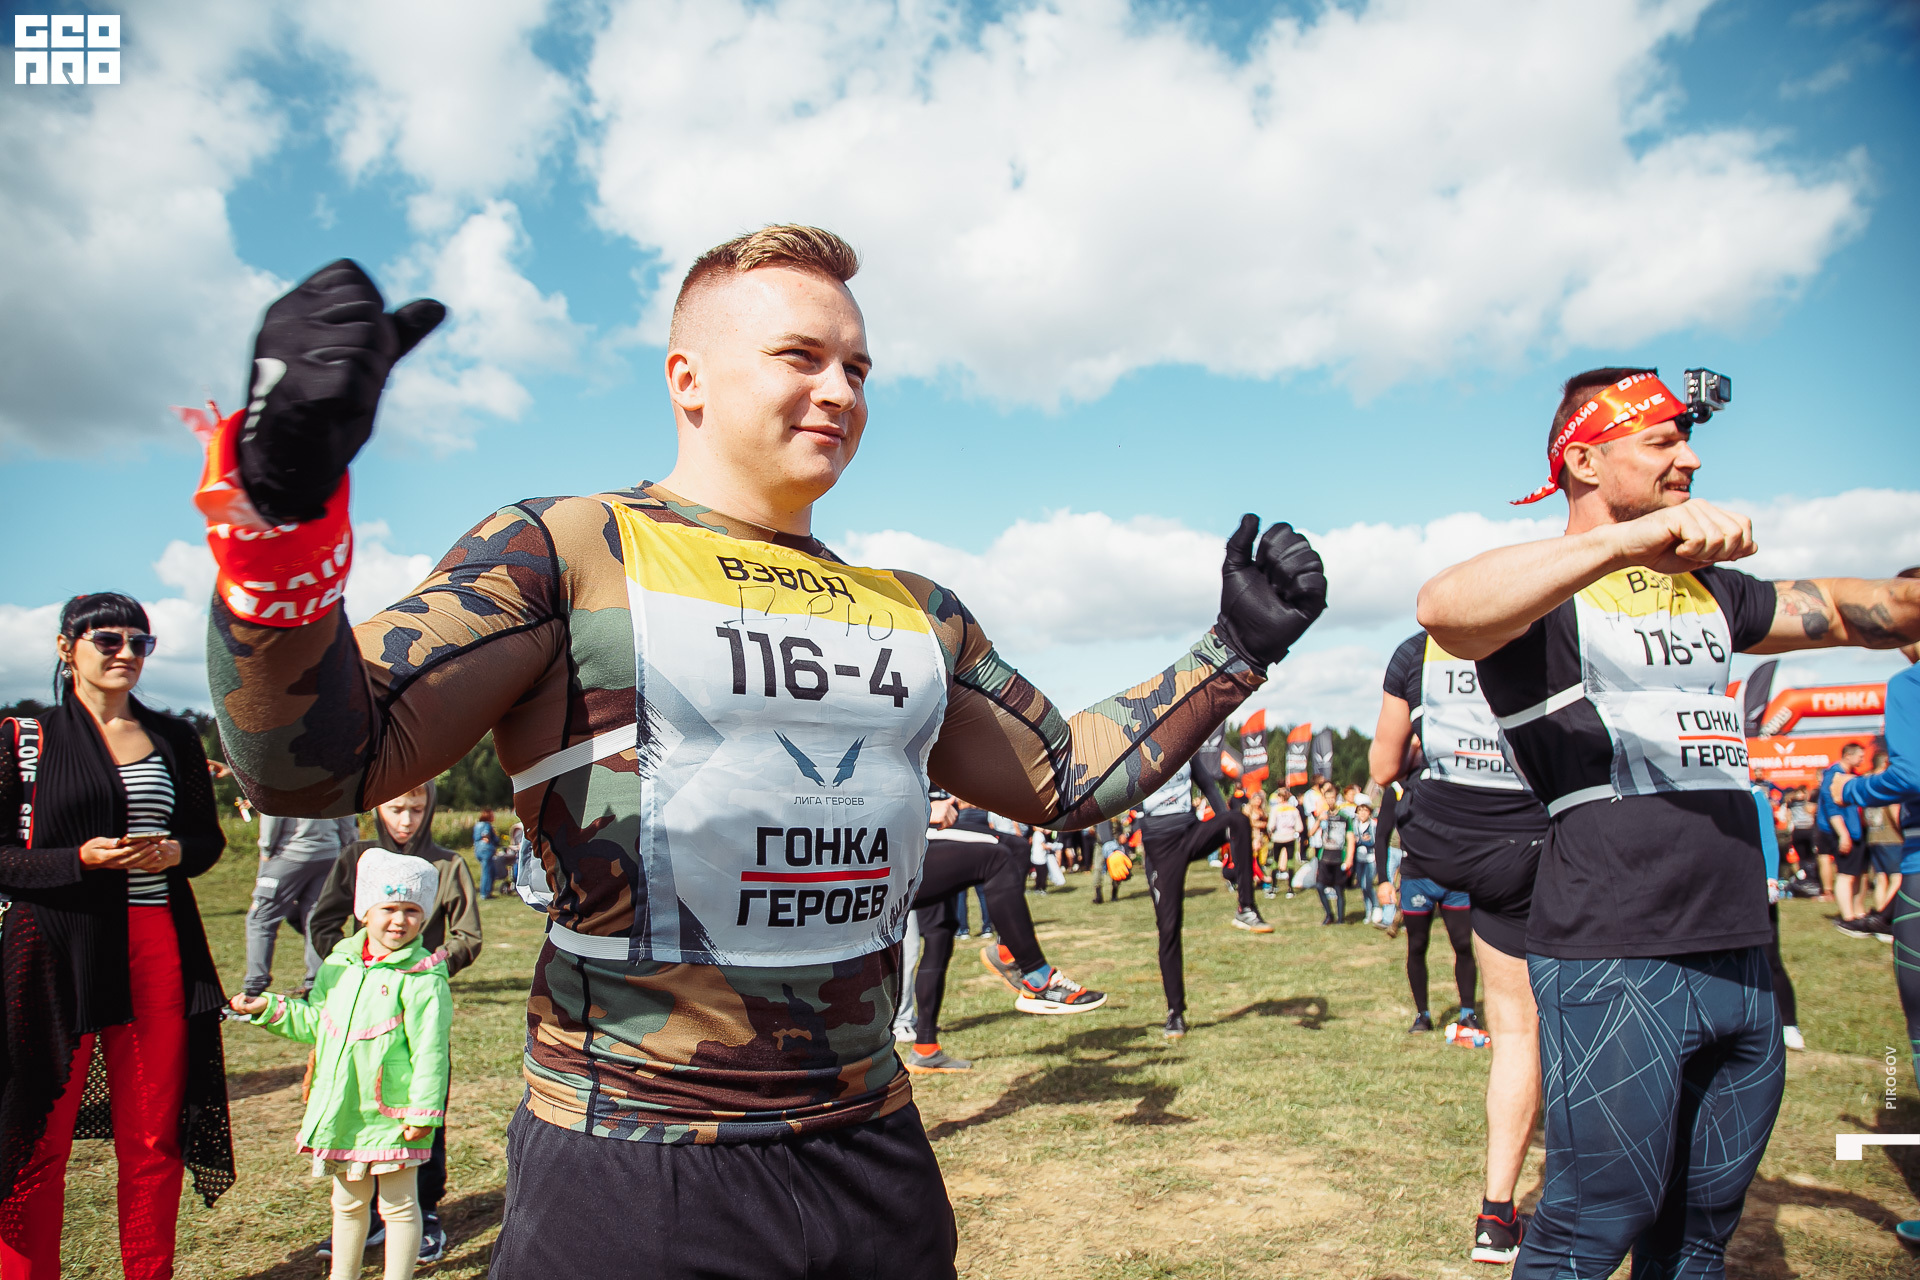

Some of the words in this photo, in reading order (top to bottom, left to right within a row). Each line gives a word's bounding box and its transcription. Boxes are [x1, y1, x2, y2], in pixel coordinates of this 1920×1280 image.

[716, 556, 856, 604] ВЗВОД
[1634, 628, 1726, 665] 116-6
[716, 626, 909, 708] 116-4
[1811, 691, 1880, 711] ГОНКА
[1677, 710, 1741, 732] ГОНКА
[18, 734, 39, 783] LOVE
[1458, 737, 1500, 751] ГОН
[793, 796, 823, 805] ЛИГА
[825, 797, 865, 806] ГЕРОЕВ
[756, 826, 889, 867] ГОНКА
[736, 884, 889, 927] ГЕРОЕВ
